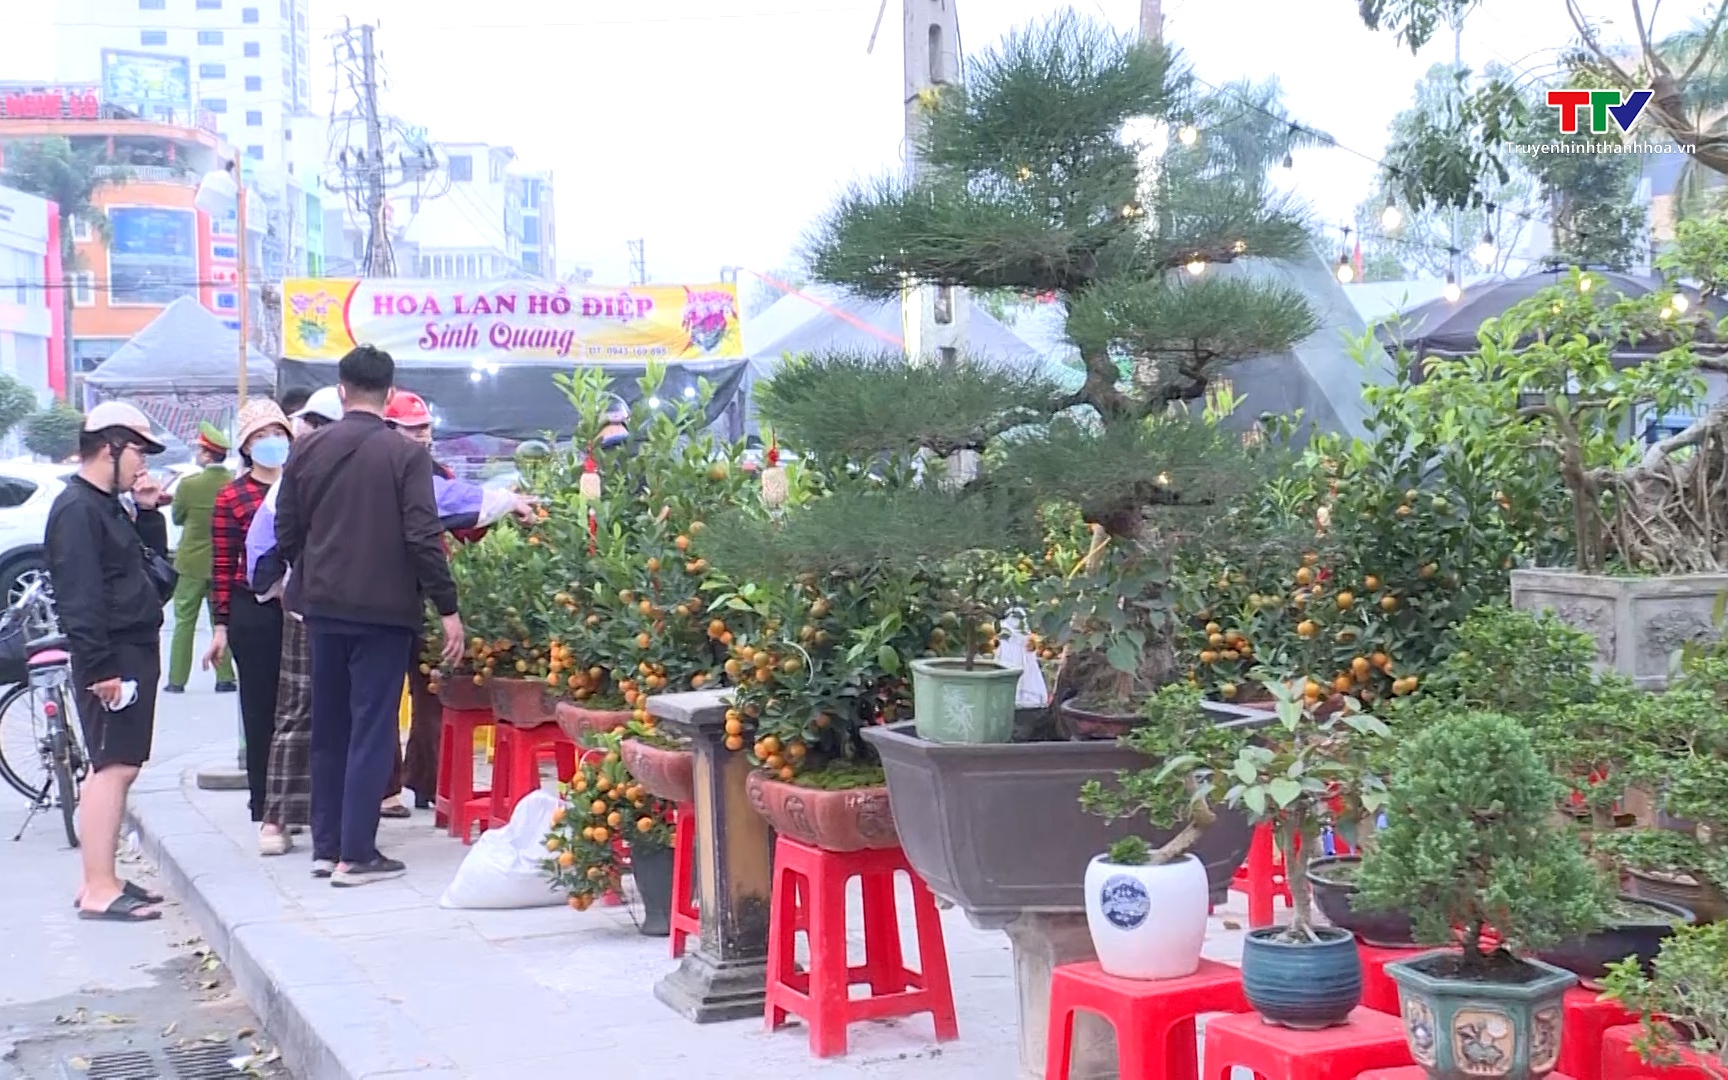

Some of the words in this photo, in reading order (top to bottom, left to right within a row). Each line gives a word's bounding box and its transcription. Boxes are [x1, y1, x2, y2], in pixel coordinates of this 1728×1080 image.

[373, 295, 441, 315] HOA
[454, 295, 516, 314] LAN
[528, 286, 571, 315] HỒ
[582, 291, 654, 323] ĐIỆP
[419, 322, 479, 349] Sinh
[489, 322, 575, 357] Quang
